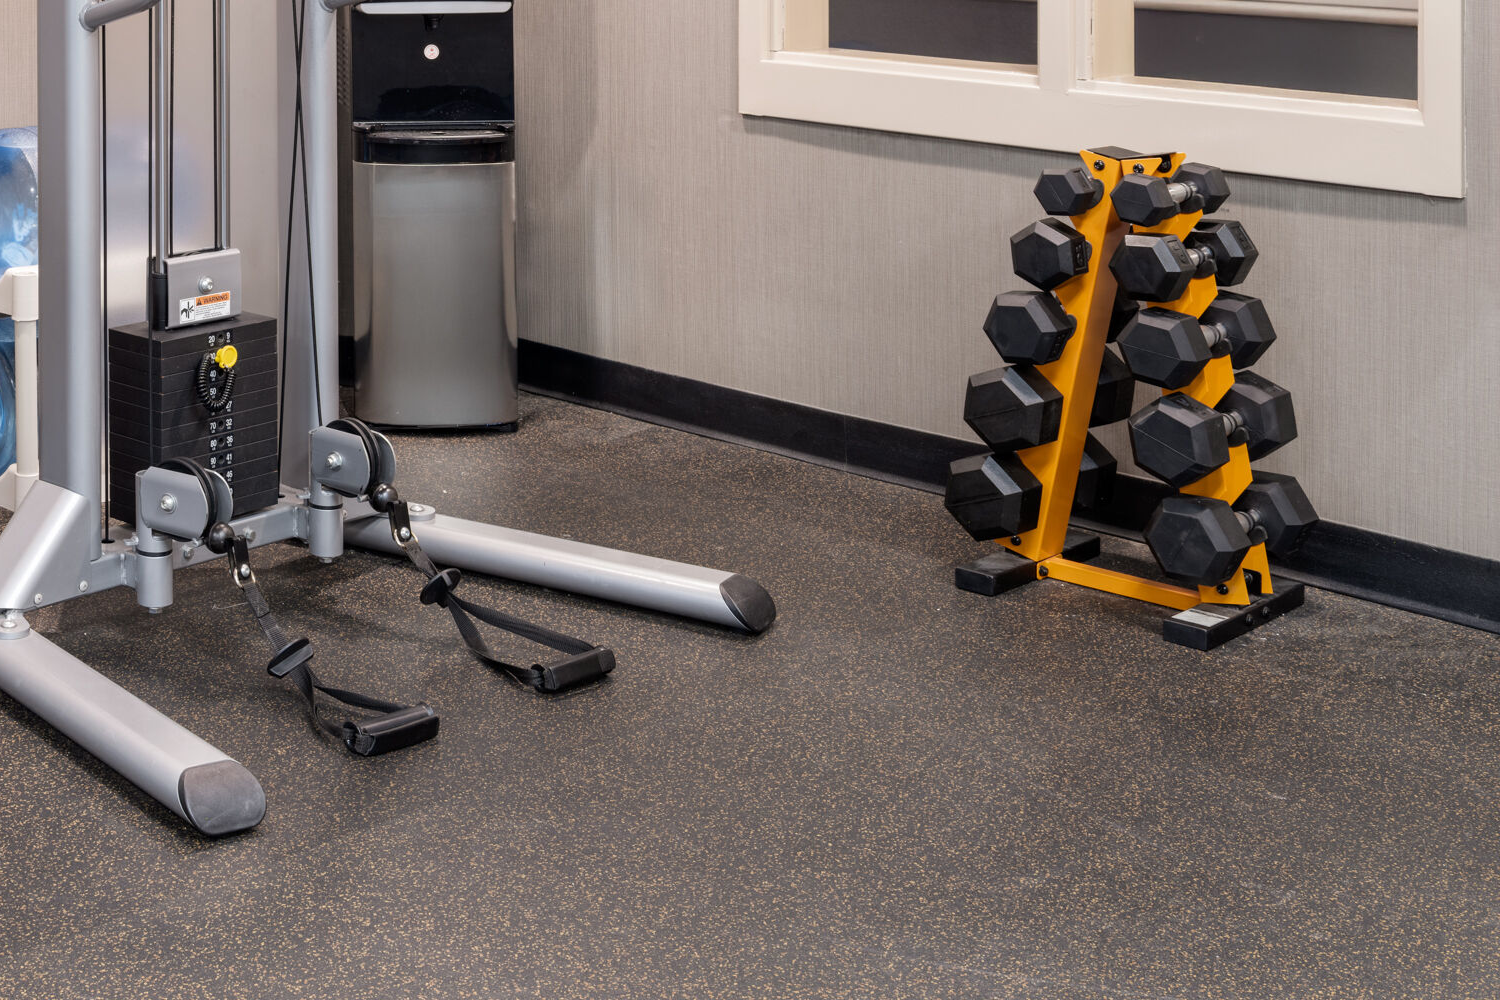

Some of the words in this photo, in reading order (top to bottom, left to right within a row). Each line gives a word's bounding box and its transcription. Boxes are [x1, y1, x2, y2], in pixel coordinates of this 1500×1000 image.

[203, 294, 228, 303] WARNING
[208, 335, 215, 343] 20
[226, 401, 232, 409] 27
[210, 422, 216, 430] 70
[226, 418, 232, 426] 32
[226, 435, 233, 443] 36
[210, 457, 216, 465] 90
[226, 453, 232, 461] 41
